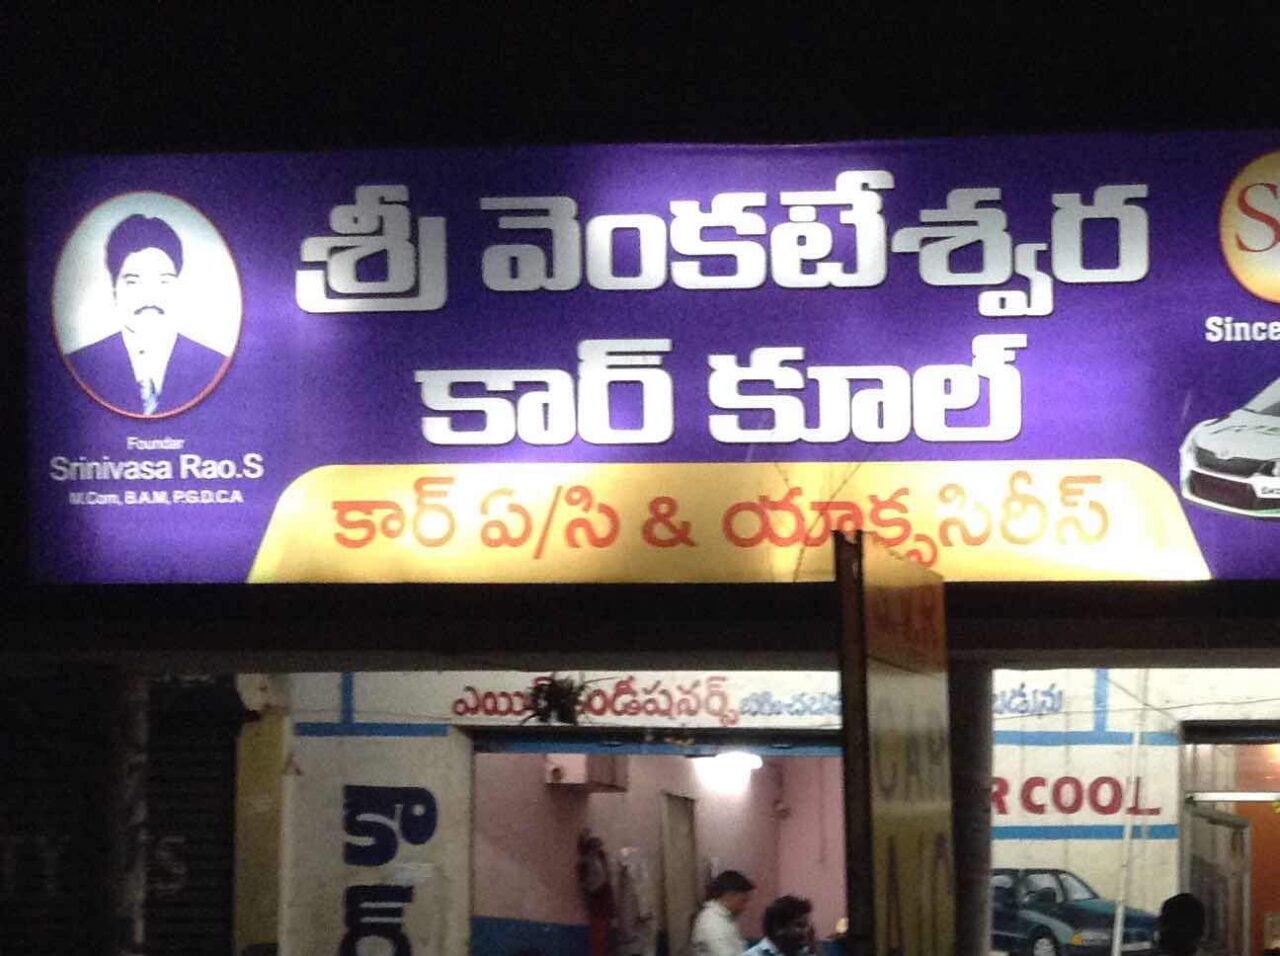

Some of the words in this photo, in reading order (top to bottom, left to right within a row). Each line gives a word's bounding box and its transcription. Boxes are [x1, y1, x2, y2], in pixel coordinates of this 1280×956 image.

[295, 184, 448, 313] శ్రీ
[480, 169, 1149, 317] వెంకటేశ్వర
[413, 337, 673, 446] కార్
[707, 333, 1027, 444] కూల్
[49, 455, 173, 481] Srinivasa
[331, 476, 456, 549] కార్
[640, 495, 696, 549] &
[1020, 775, 1162, 817] COOL
